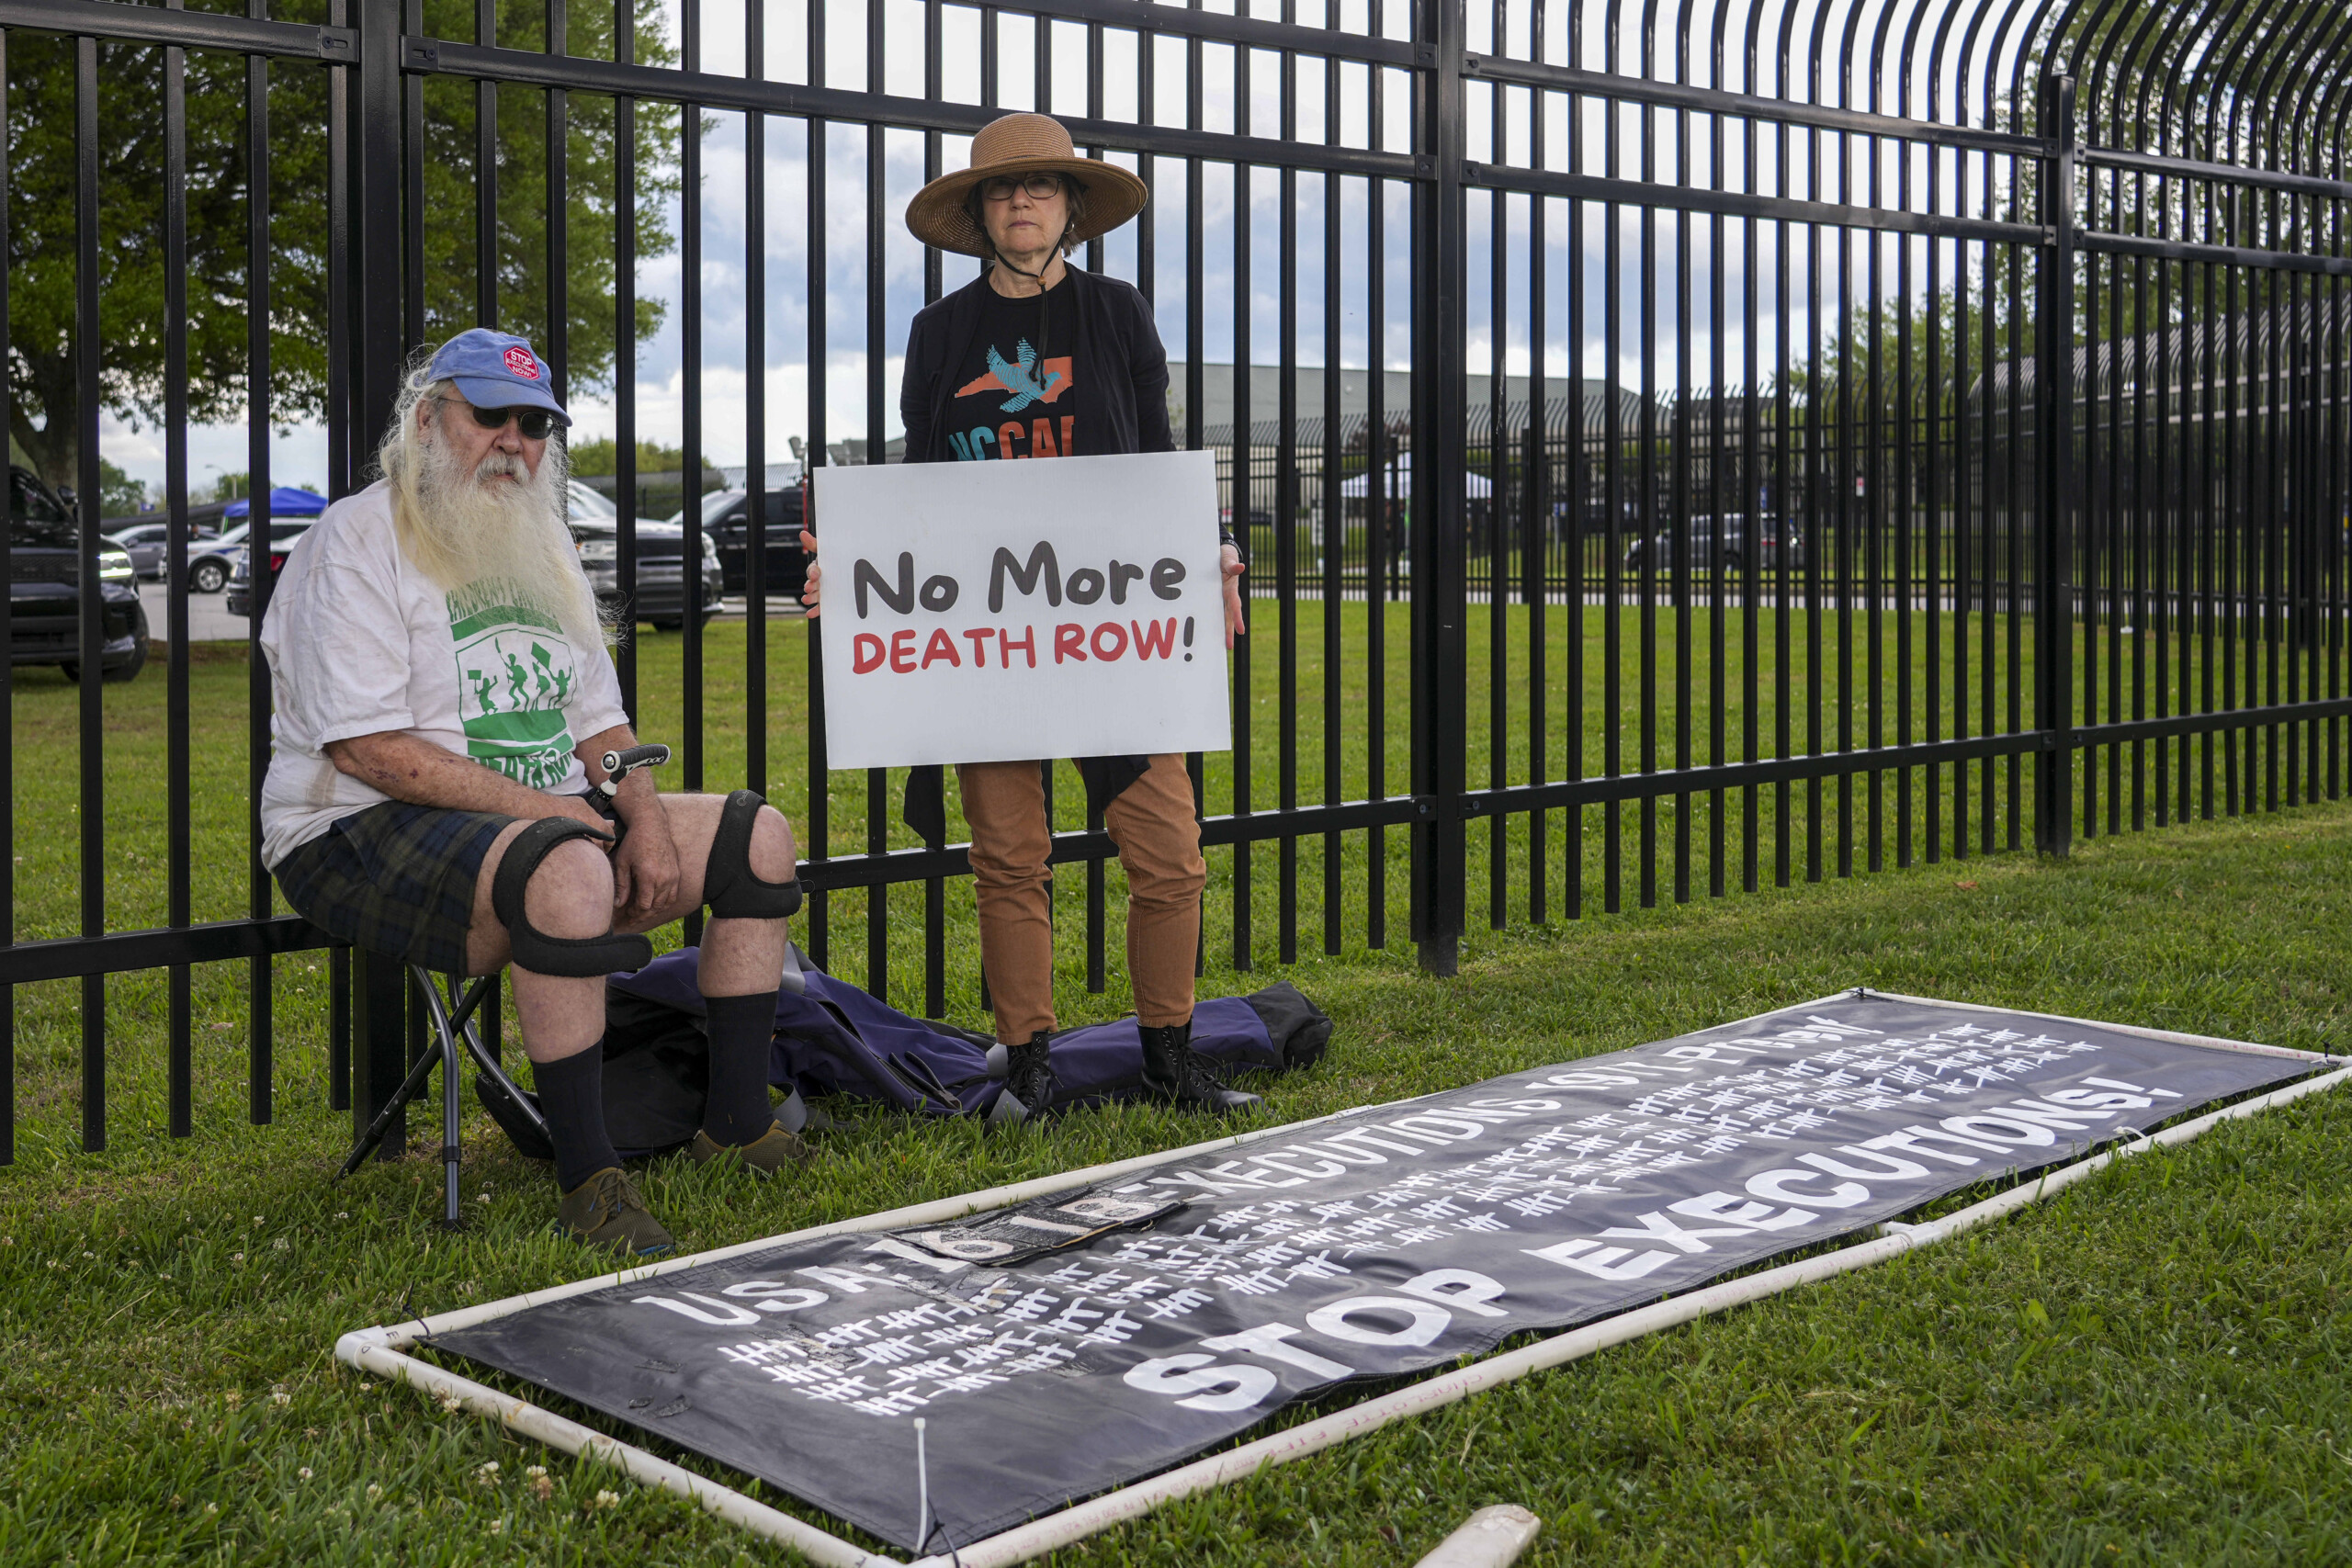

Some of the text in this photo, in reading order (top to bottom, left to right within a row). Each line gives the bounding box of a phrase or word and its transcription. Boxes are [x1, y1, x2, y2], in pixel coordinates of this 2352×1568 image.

[506, 358, 536, 374] EXECUTIONS
[511, 351, 533, 366] STOP
[854, 540, 1187, 619] No More
[853, 616, 1194, 674] DEATH ROW!
[632, 1263, 912, 1325] USA:
[1113, 1098, 1561, 1203] EXECUTIONS
[1123, 1268, 1510, 1412] STOP
[1521, 1077, 2185, 1280] EXECUTIONS!
